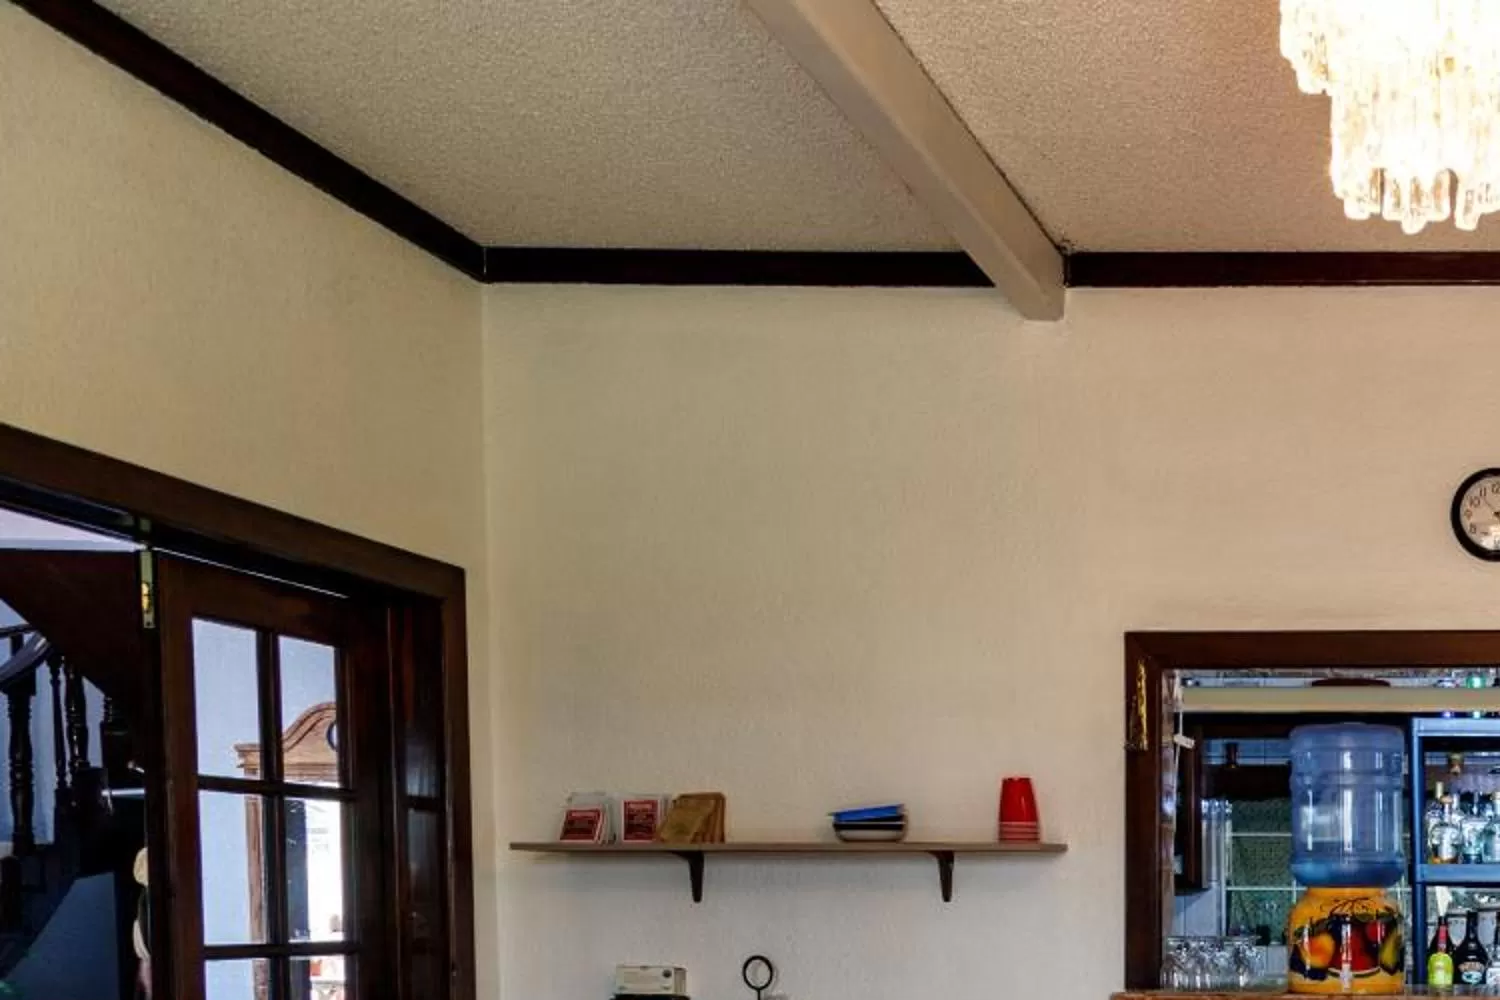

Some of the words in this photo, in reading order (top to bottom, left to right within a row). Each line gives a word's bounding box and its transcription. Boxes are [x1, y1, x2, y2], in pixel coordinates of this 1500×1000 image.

[1479, 487, 1487, 497] 11
[1491, 481, 1500, 494] 12
[1469, 496, 1480, 508] 10
